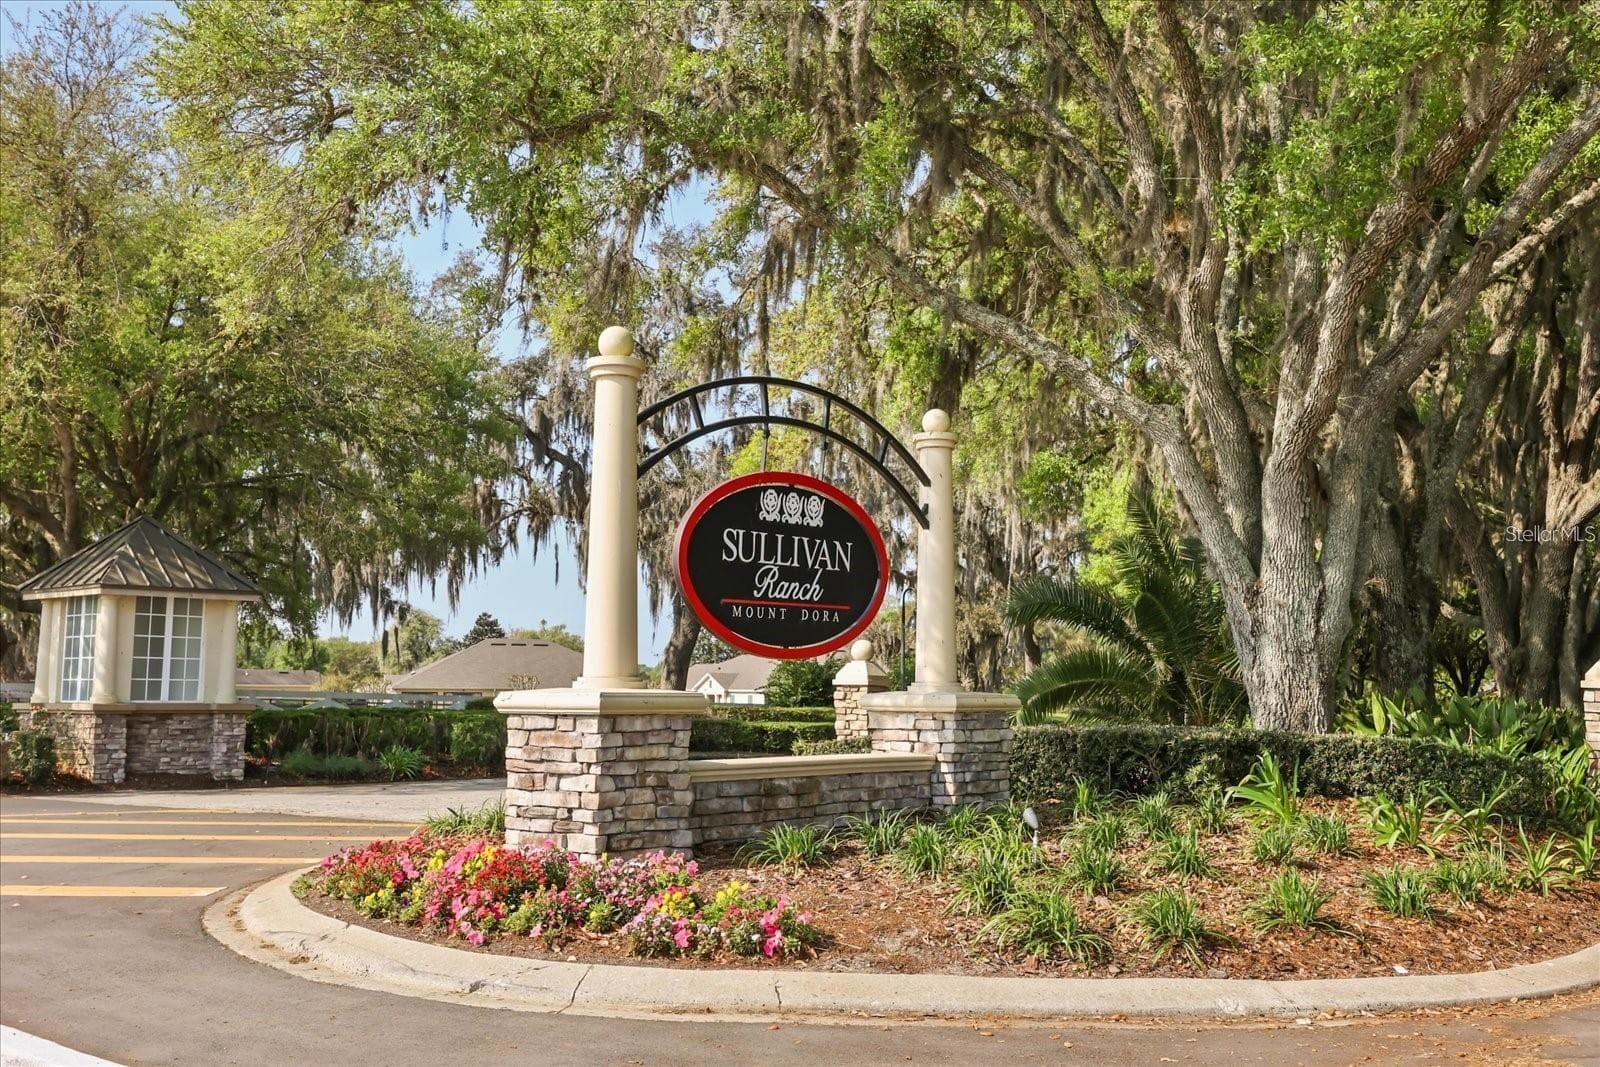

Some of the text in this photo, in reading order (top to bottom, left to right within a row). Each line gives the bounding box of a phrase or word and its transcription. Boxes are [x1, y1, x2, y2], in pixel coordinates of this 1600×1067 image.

[722, 528, 853, 572] SULLIVAN
[753, 565, 824, 601] Ranch
[732, 606, 840, 622] MOUNT DORA
